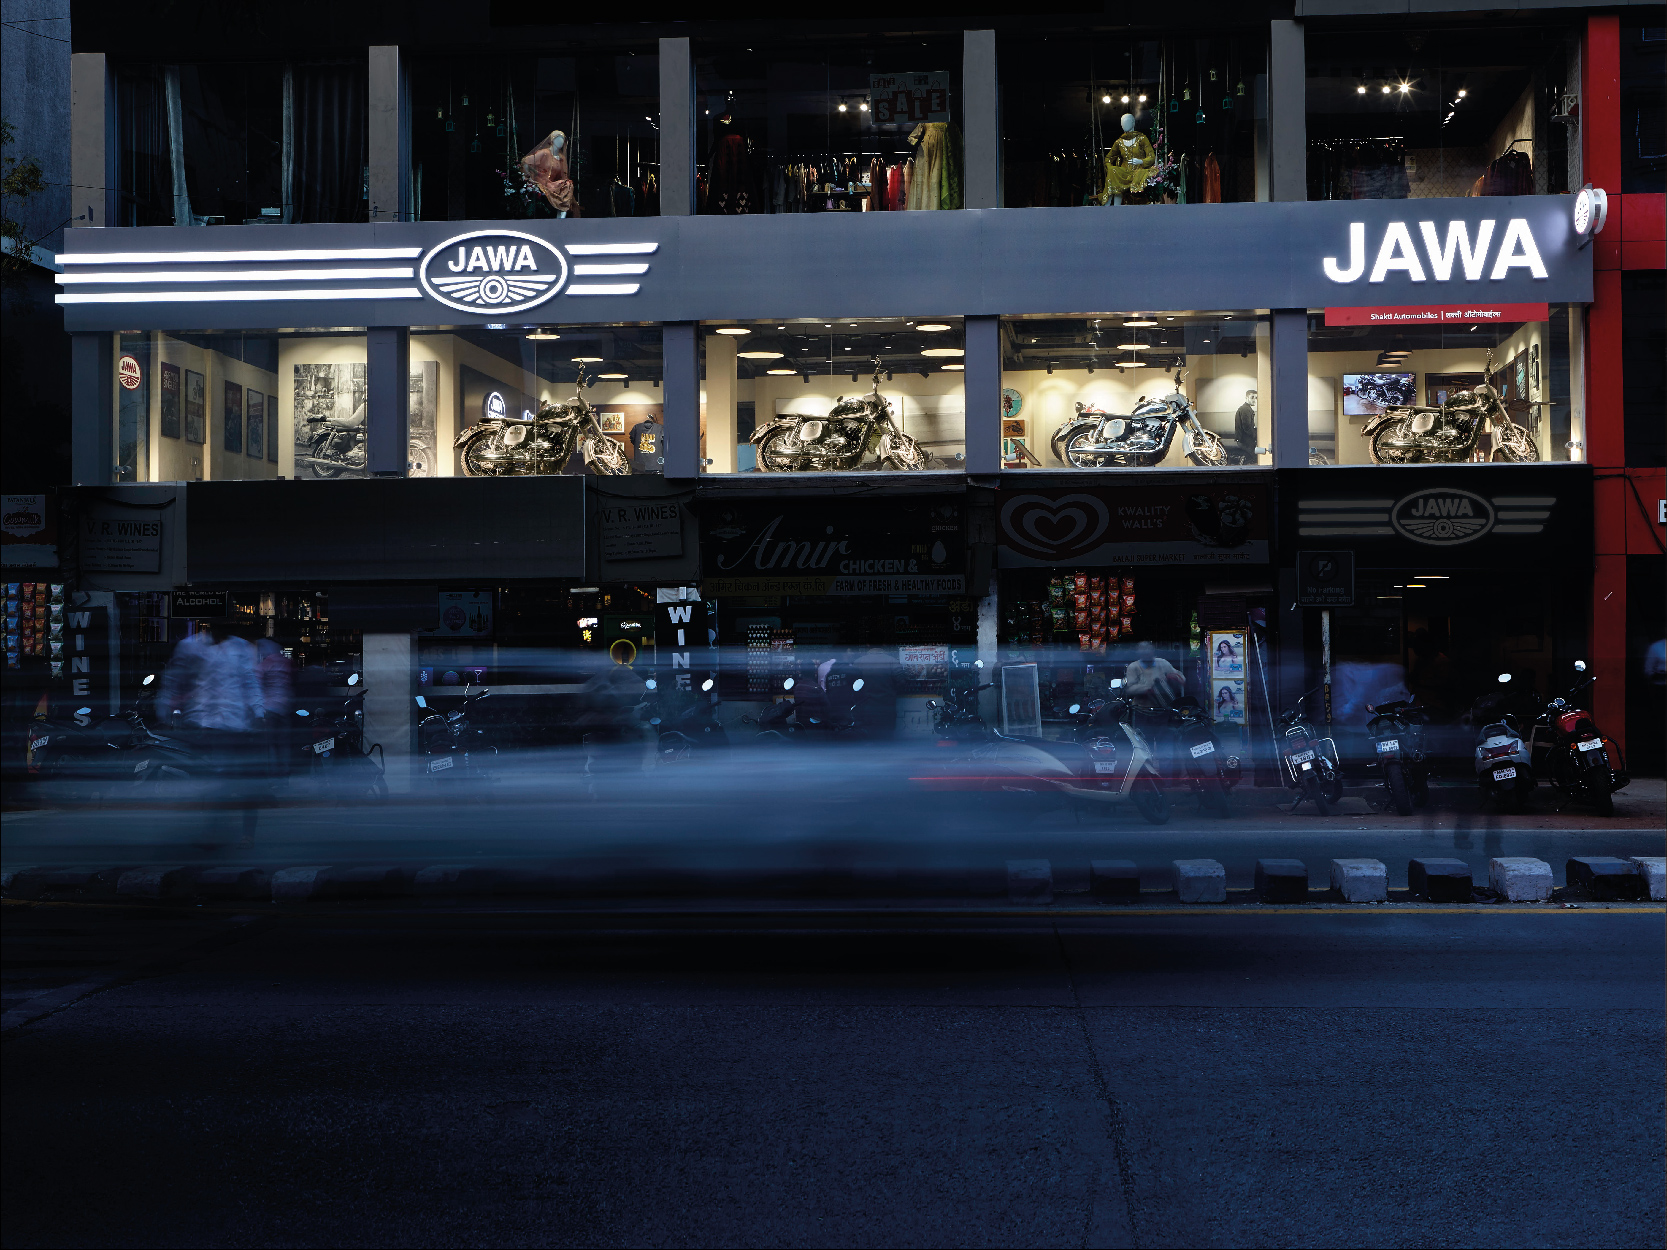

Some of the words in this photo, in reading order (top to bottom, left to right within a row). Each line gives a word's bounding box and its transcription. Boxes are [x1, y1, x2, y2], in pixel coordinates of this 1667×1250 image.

[878, 92, 941, 121] SALE
[1323, 218, 1549, 283] JAWA
[447, 244, 538, 274] JAWA
[1370, 312, 1393, 321] Shakti
[1393, 311, 1439, 320] Automobiles
[121, 360, 138, 375] JAWA
[602, 509, 614, 524] V.
[617, 508, 631, 522] R.
[634, 504, 678, 522] WINES
[1117, 505, 1171, 516] KWALITY
[1411, 498, 1474, 518] JAWA
[87, 521, 97, 535] V.
[101, 521, 113, 536] R.
[117, 522, 159, 537] WINES
[1121, 519, 1163, 529] WALL'S
[717, 514, 853, 570] Amir
[1112, 555, 1135, 563] BALAJI
[1136, 554, 1158, 562] SUPER
[1158, 552, 1186, 562] MARKET
[840, 559, 904, 574] CHICKEN
[907, 559, 919, 573] &
[834, 581, 857, 593] FARM
[857, 580, 868, 592] OF
[868, 580, 893, 592] FRESH
[901, 579, 936, 592] HEALTHY
[936, 578, 962, 591] FOODS
[1307, 586, 1317, 594] No
[176, 598, 223, 606] ALCOHOL
[67, 611, 92, 727] WINES
